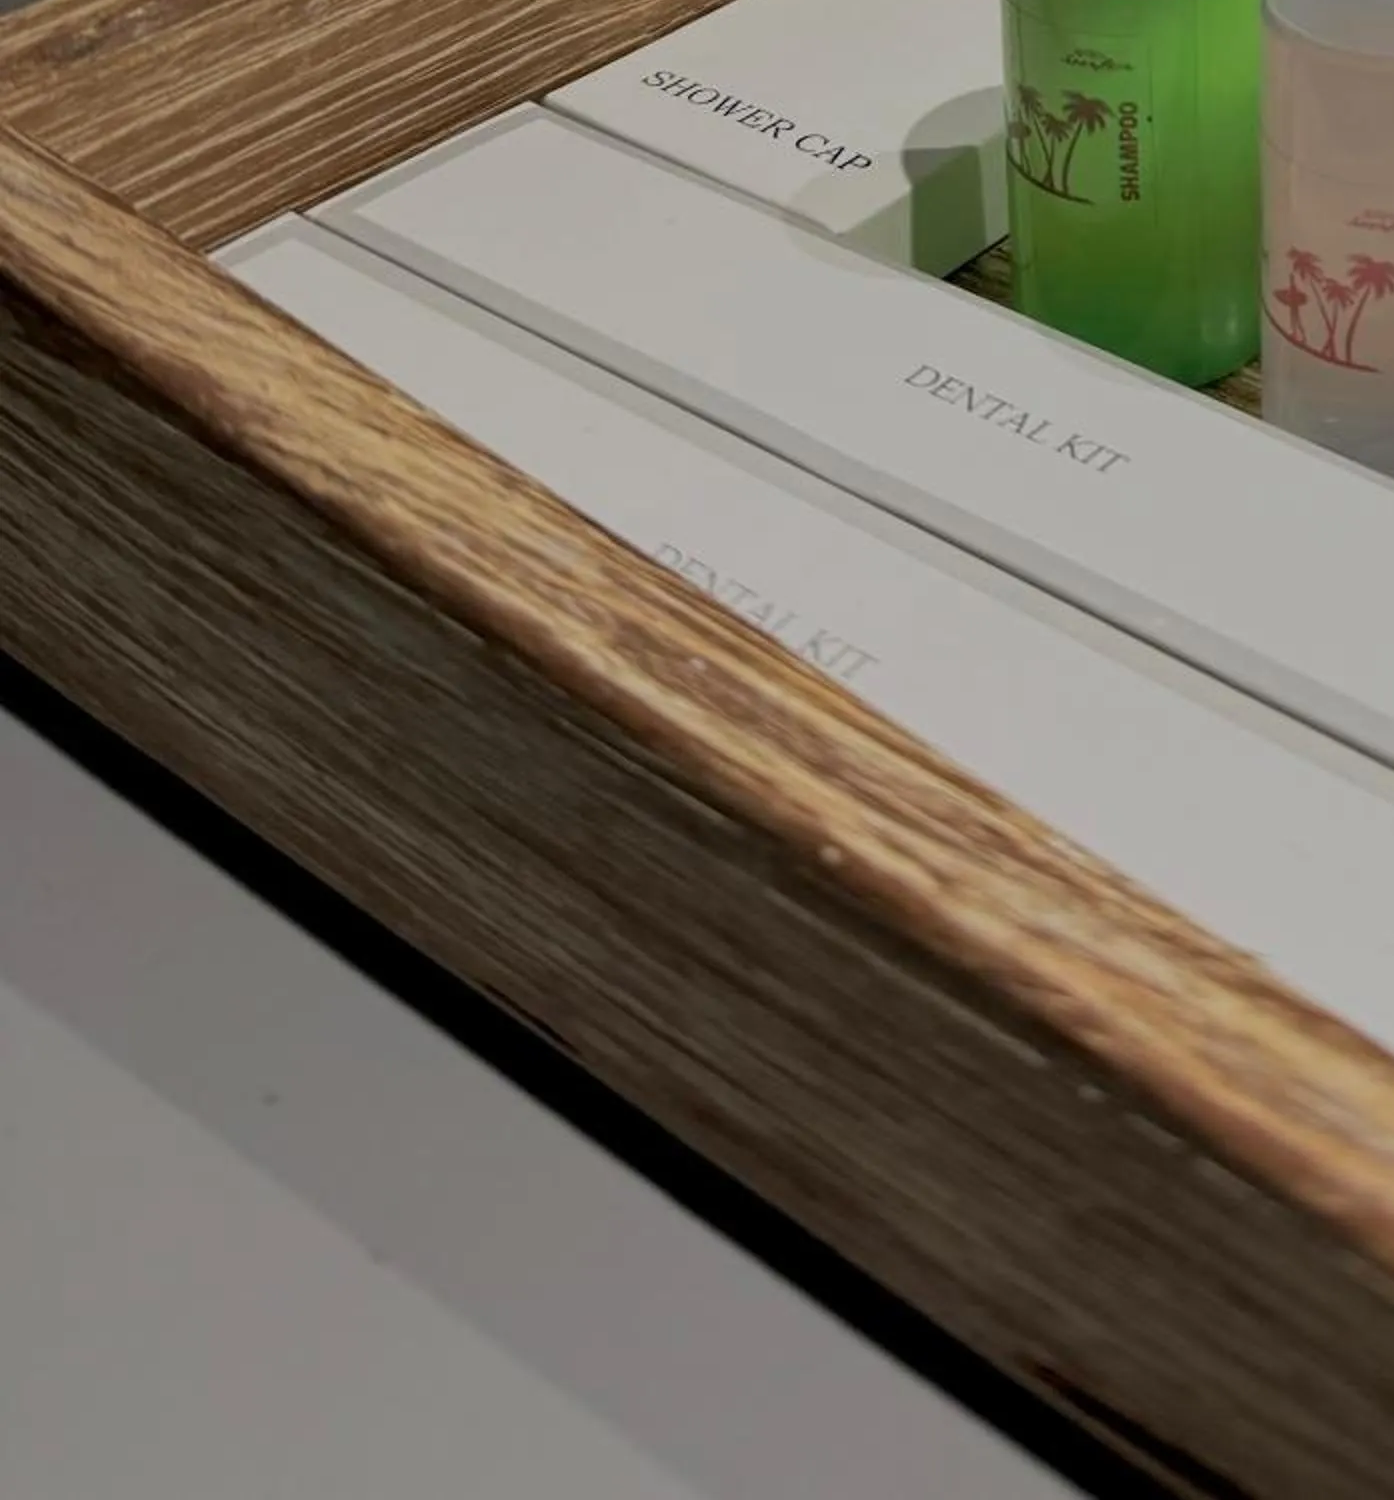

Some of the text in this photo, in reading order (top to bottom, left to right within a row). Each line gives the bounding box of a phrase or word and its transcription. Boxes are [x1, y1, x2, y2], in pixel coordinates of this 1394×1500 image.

[641, 69, 873, 171] SHOWER CAP
[1118, 101, 1140, 202] SHAMPOO
[904, 363, 1132, 473] DENTAL KIT
[802, 627, 881, 680] KIT
